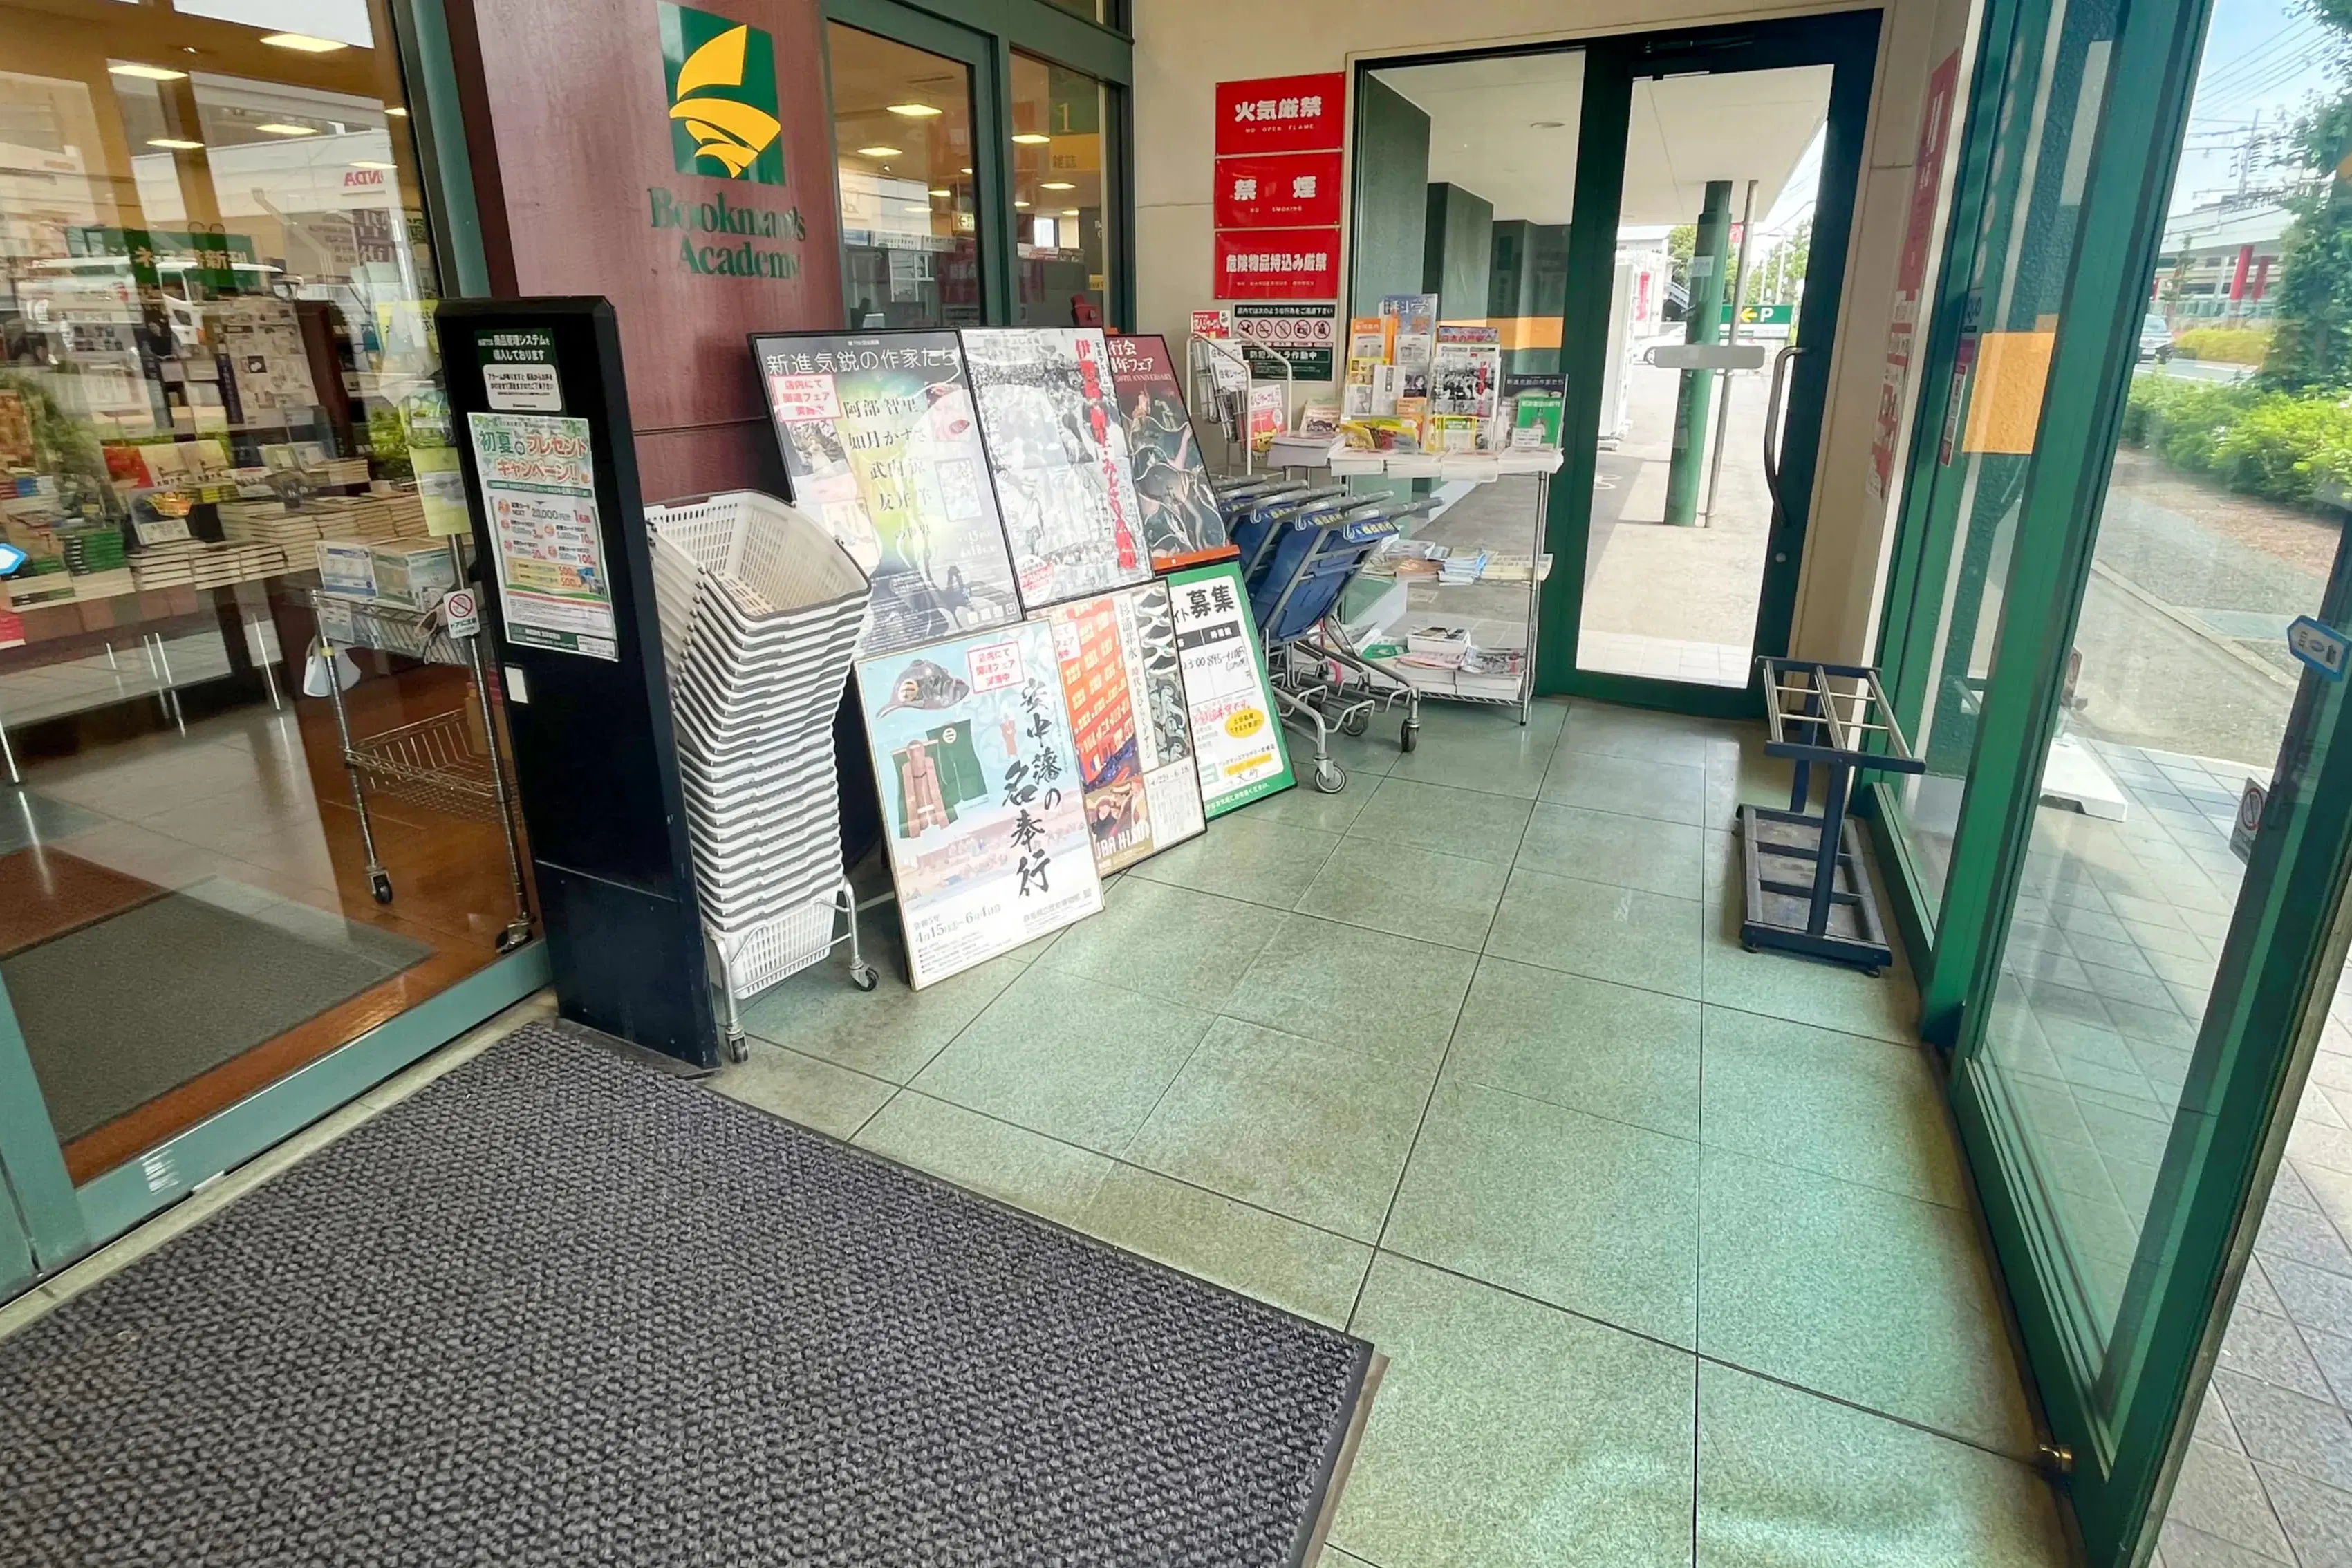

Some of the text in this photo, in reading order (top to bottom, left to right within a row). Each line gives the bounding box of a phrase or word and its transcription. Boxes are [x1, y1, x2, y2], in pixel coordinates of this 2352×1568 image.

[1235, 95, 1322, 122] 火気厳禁
[647, 187, 805, 242] Bookman's
[680, 237, 801, 278] Academy
[1226, 252, 1327, 272] 危険物品持込み厳禁
[1760, 307, 1774, 322] P
[766, 348, 960, 376] 新進気鋭の作家たち
[783, 391, 830, 403] 関連フェア
[785, 379, 823, 391] 店内にて
[478, 429, 589, 459] 初夏のプレゼント
[1020, 677, 1063, 810] 安中藩の
[1002, 760, 1052, 899] 名奉行
